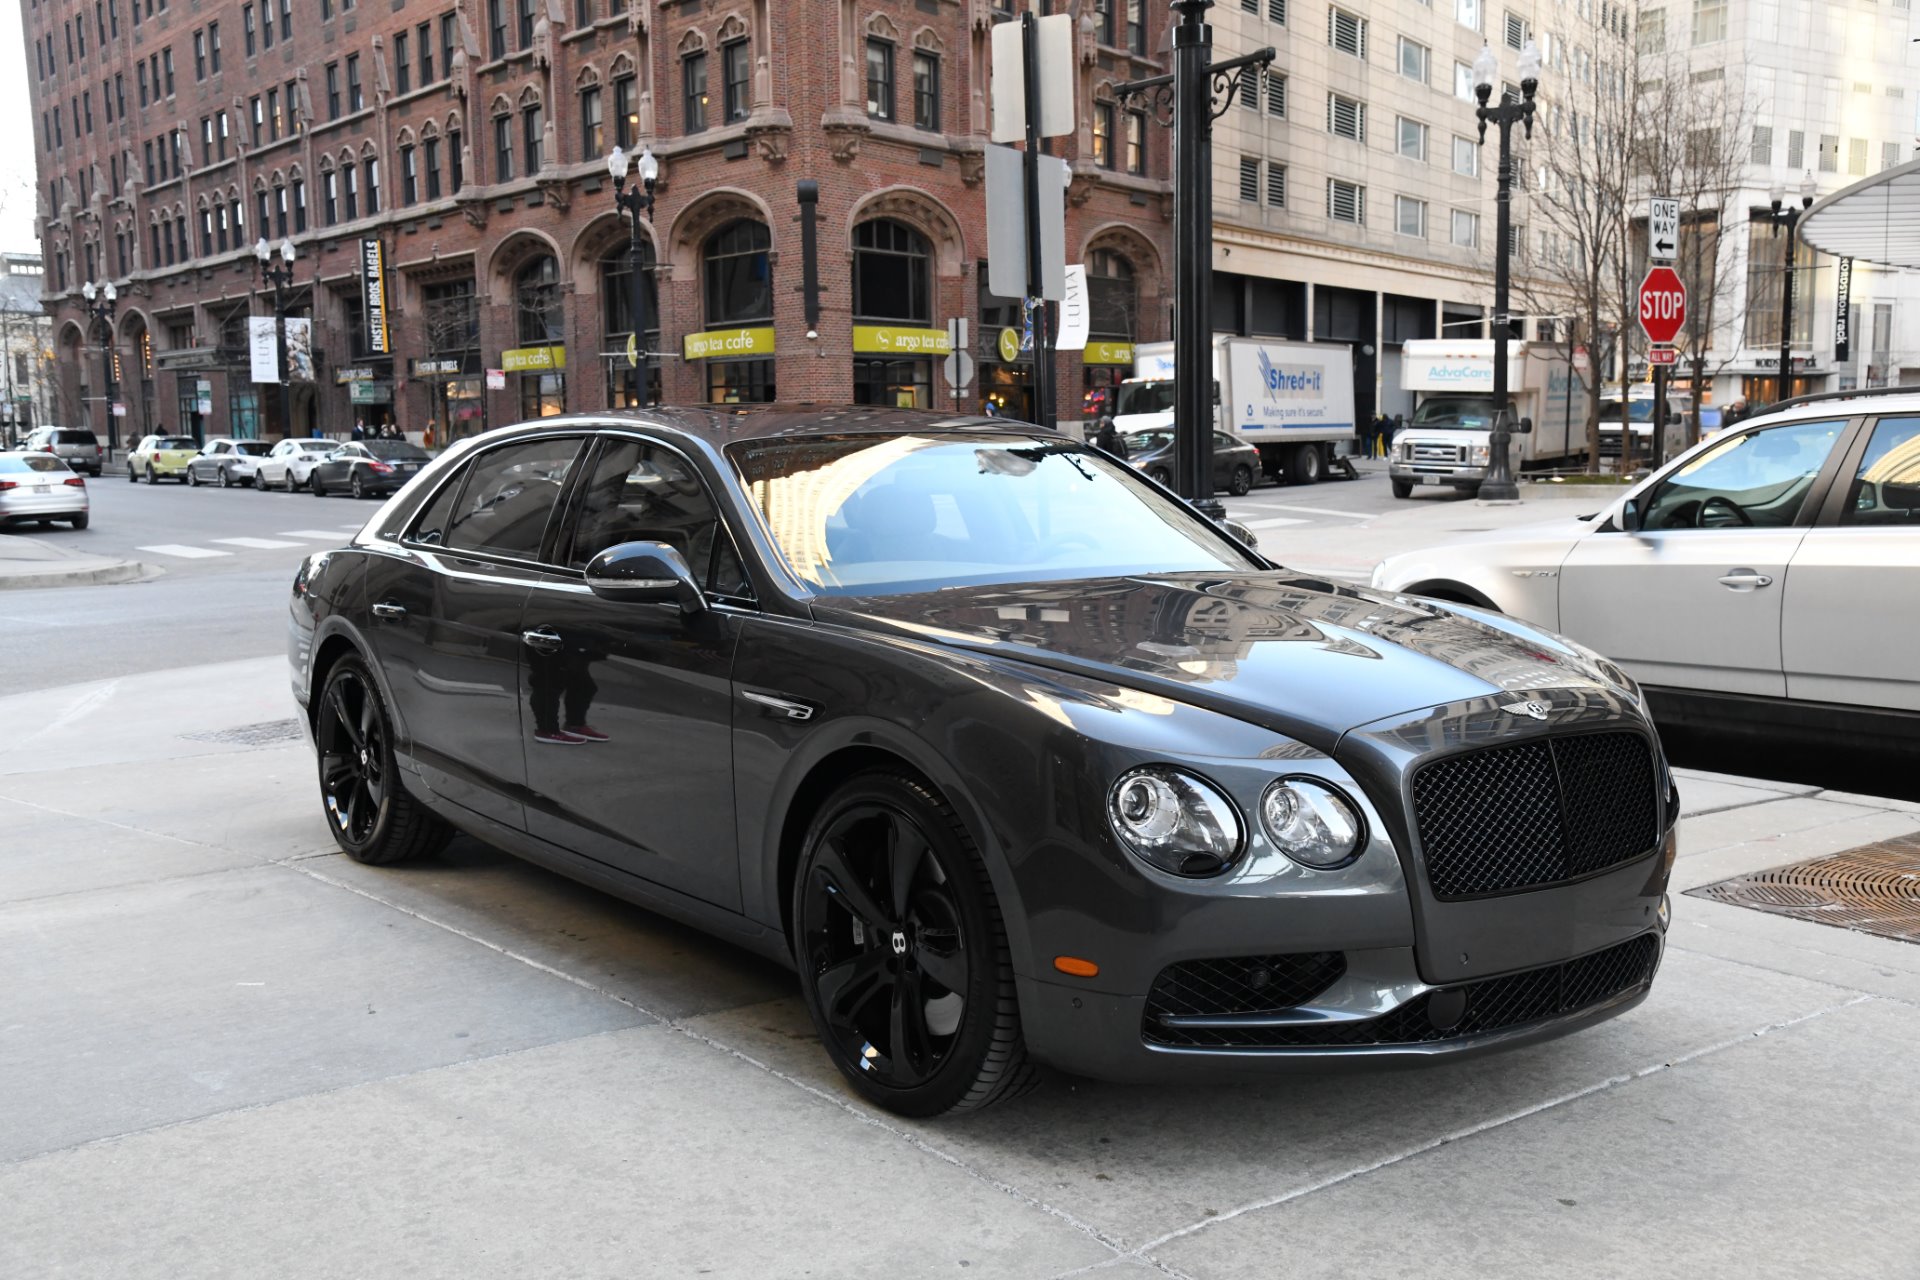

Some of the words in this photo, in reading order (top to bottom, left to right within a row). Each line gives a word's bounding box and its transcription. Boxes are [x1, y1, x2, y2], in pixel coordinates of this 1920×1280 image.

[1653, 203, 1676, 219] ONE
[1653, 220, 1676, 236] WAY
[366, 241, 379, 278] BAGELS
[1641, 290, 1683, 320] STOP
[371, 308, 384, 352] EINSTEIN
[1836, 319, 1847, 344] rack
[726, 330, 754, 350] café
[895, 335, 920, 351] argo
[922, 334, 934, 349] tea
[528, 347, 550, 365] café
[1651, 351, 1661, 361] ALL
[1269, 368, 1321, 391] Shred-it
[1428, 365, 1492, 378] AdvaCare
